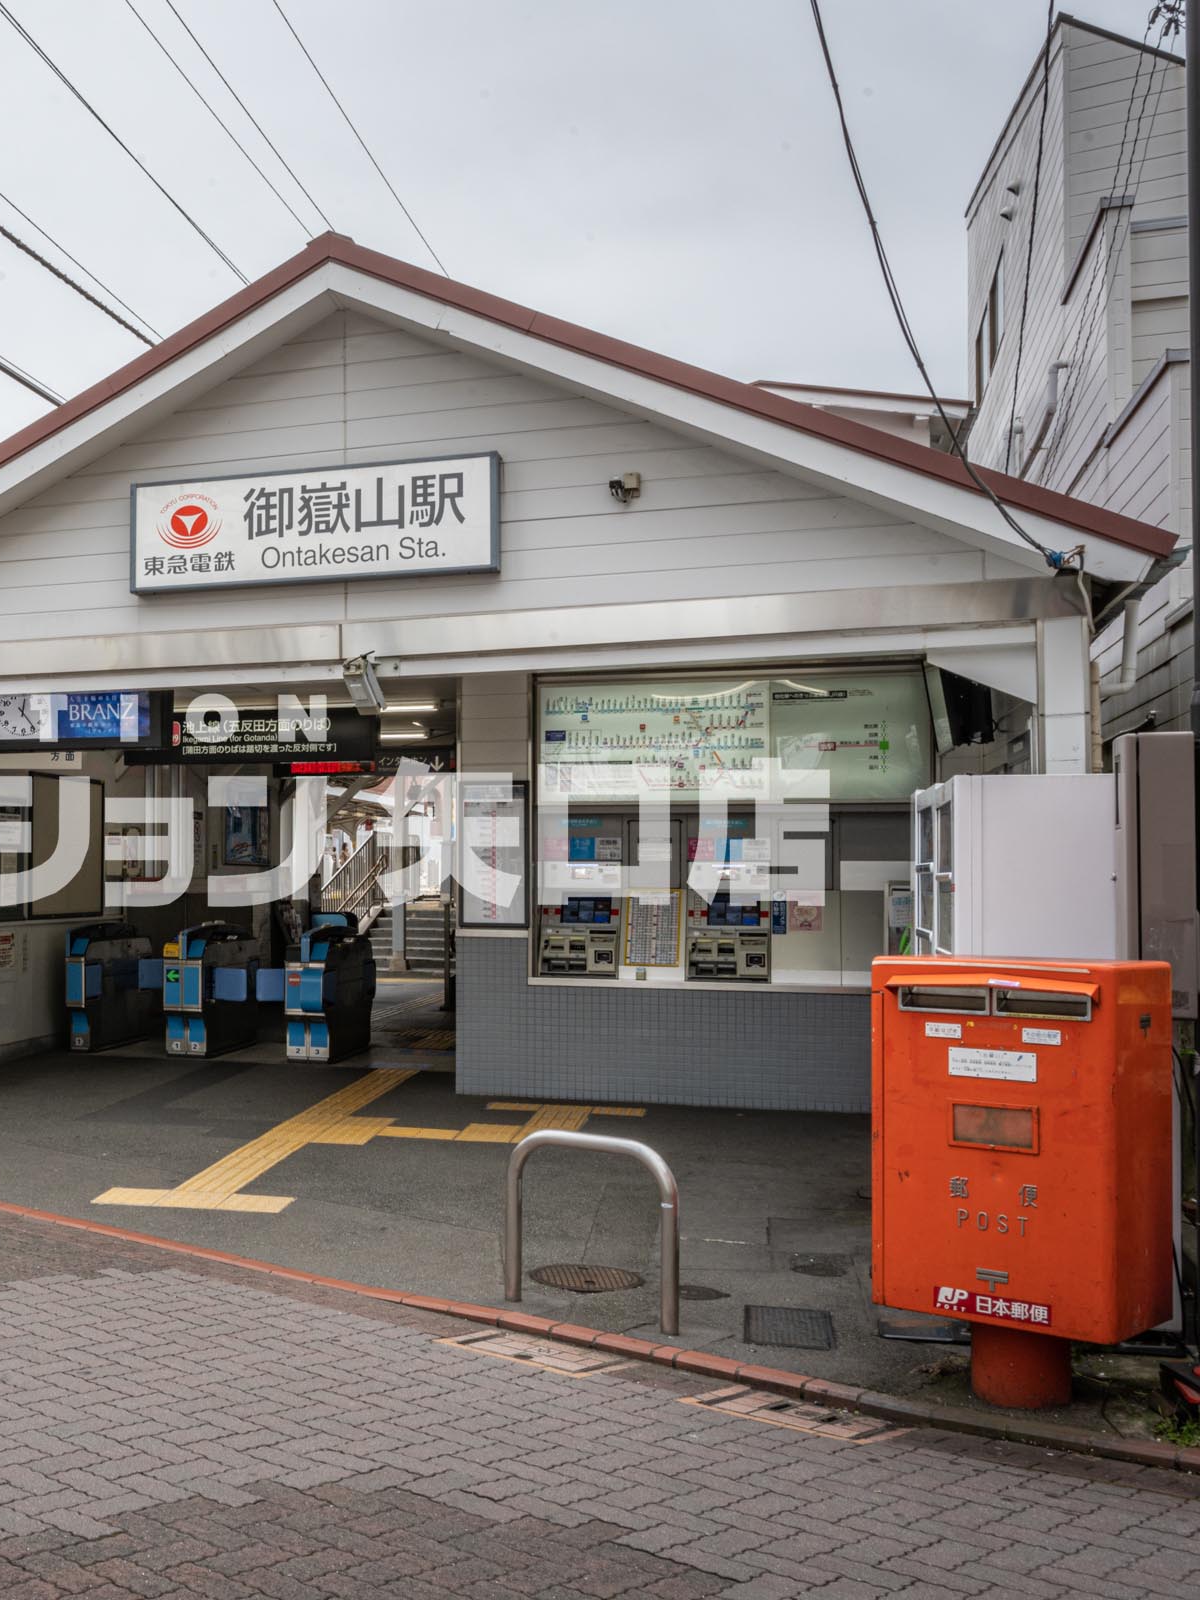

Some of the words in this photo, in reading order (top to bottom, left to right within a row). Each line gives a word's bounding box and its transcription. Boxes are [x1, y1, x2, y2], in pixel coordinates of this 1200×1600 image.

[160, 497, 178, 514] TOKYU
[178, 493, 218, 511] CORPORATION
[243, 471, 466, 541] 御嶽山駅
[143, 551, 236, 577] 東急電鉄
[261, 542, 390, 569] Ontakesan
[399, 536, 446, 560] Sta.
[69, 702, 136, 721] BRANZ
[183, 735, 211, 745] Ikegami
[213, 735, 228, 743] Line
[229, 734, 242, 744] (for
[244, 733, 278, 743] Gotanda)
[949, 1175, 1039, 1209] 郵便
[956, 1207, 1030, 1237] POST
[936, 1302, 967, 1312] POST
[975, 1294, 1049, 1325] 日本郵便
